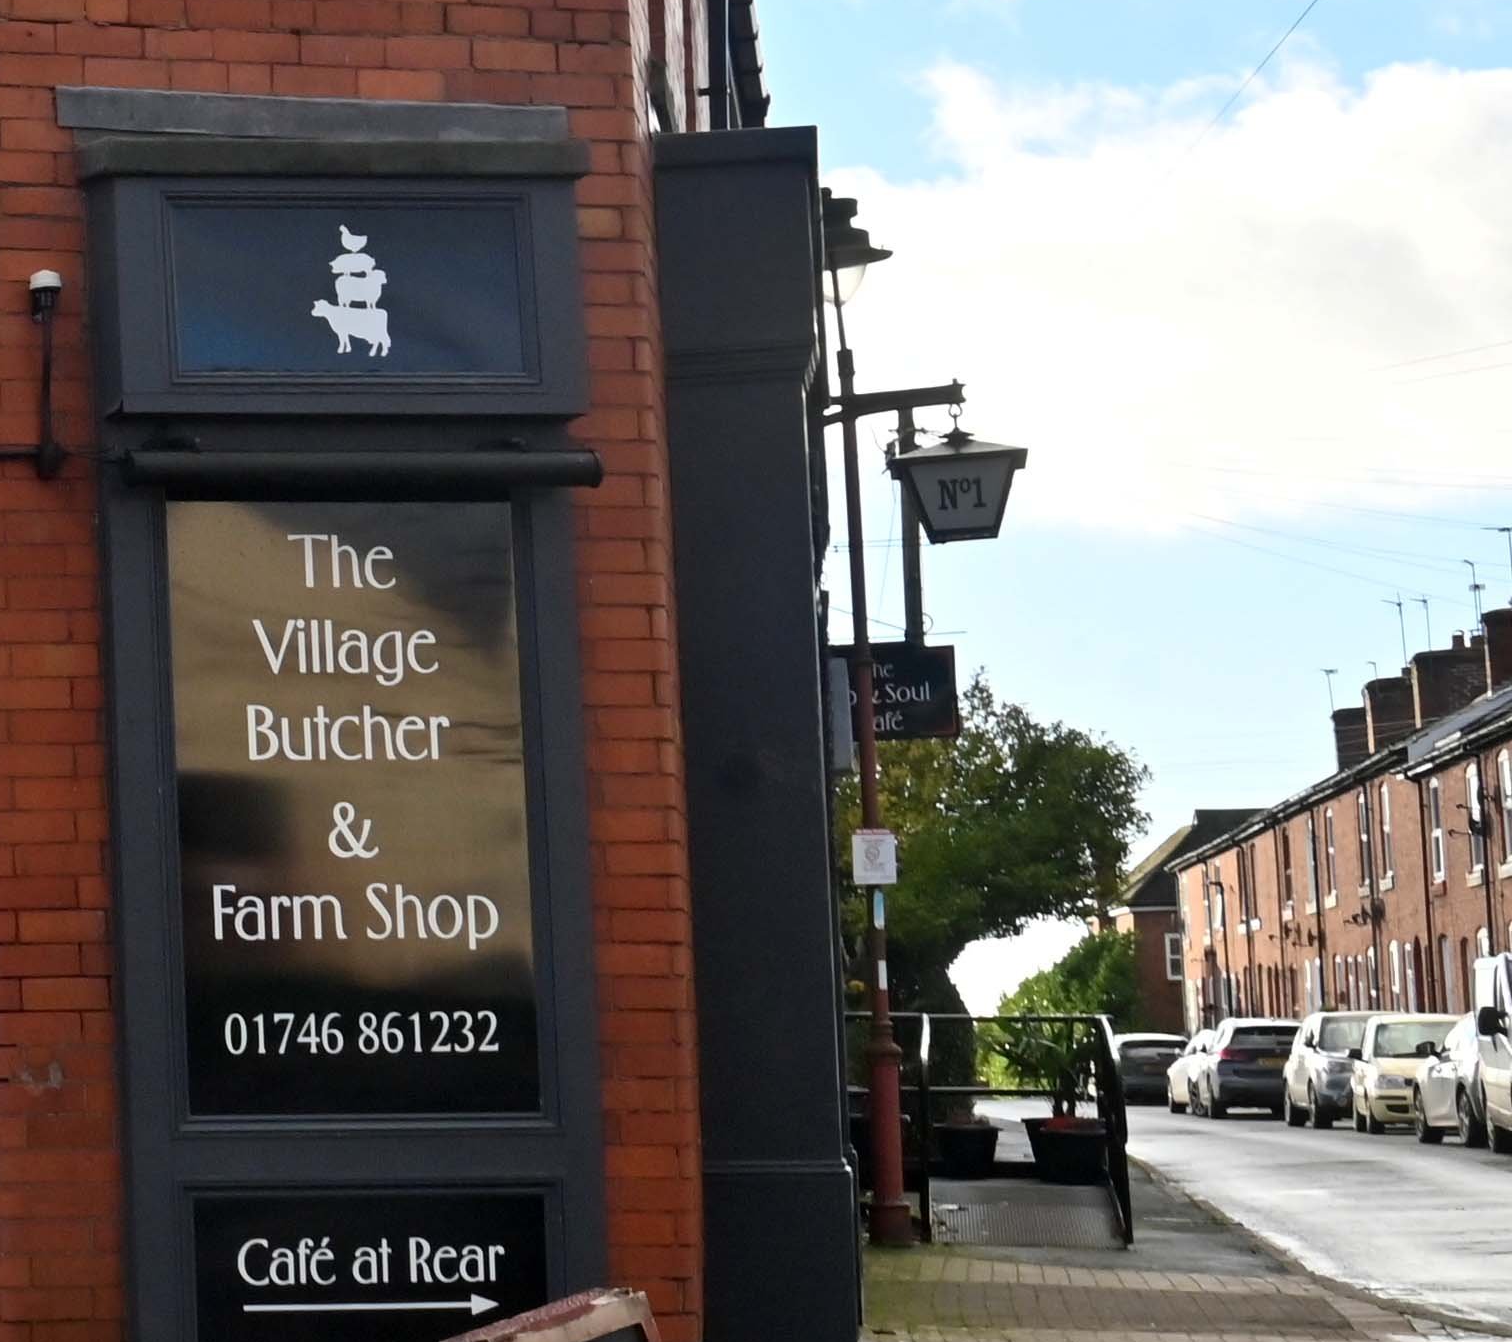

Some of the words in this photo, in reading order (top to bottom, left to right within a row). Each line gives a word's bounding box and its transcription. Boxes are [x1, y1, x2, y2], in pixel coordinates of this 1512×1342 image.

[287, 533, 397, 589] The
[252, 618, 440, 687] Village
[885, 680, 931, 704] Soul
[246, 704, 451, 762] Butcher
[872, 710, 905, 732] afé
[328, 801, 380, 859] &
[212, 884, 348, 941] Farm
[365, 882, 500, 951] Shop
[224, 1011, 345, 1056] 01746
[358, 1009, 501, 1055] 861232
[237, 1234, 337, 1287] Café
[352, 1236, 392, 1285] at
[408, 1236, 506, 1284] Rear
